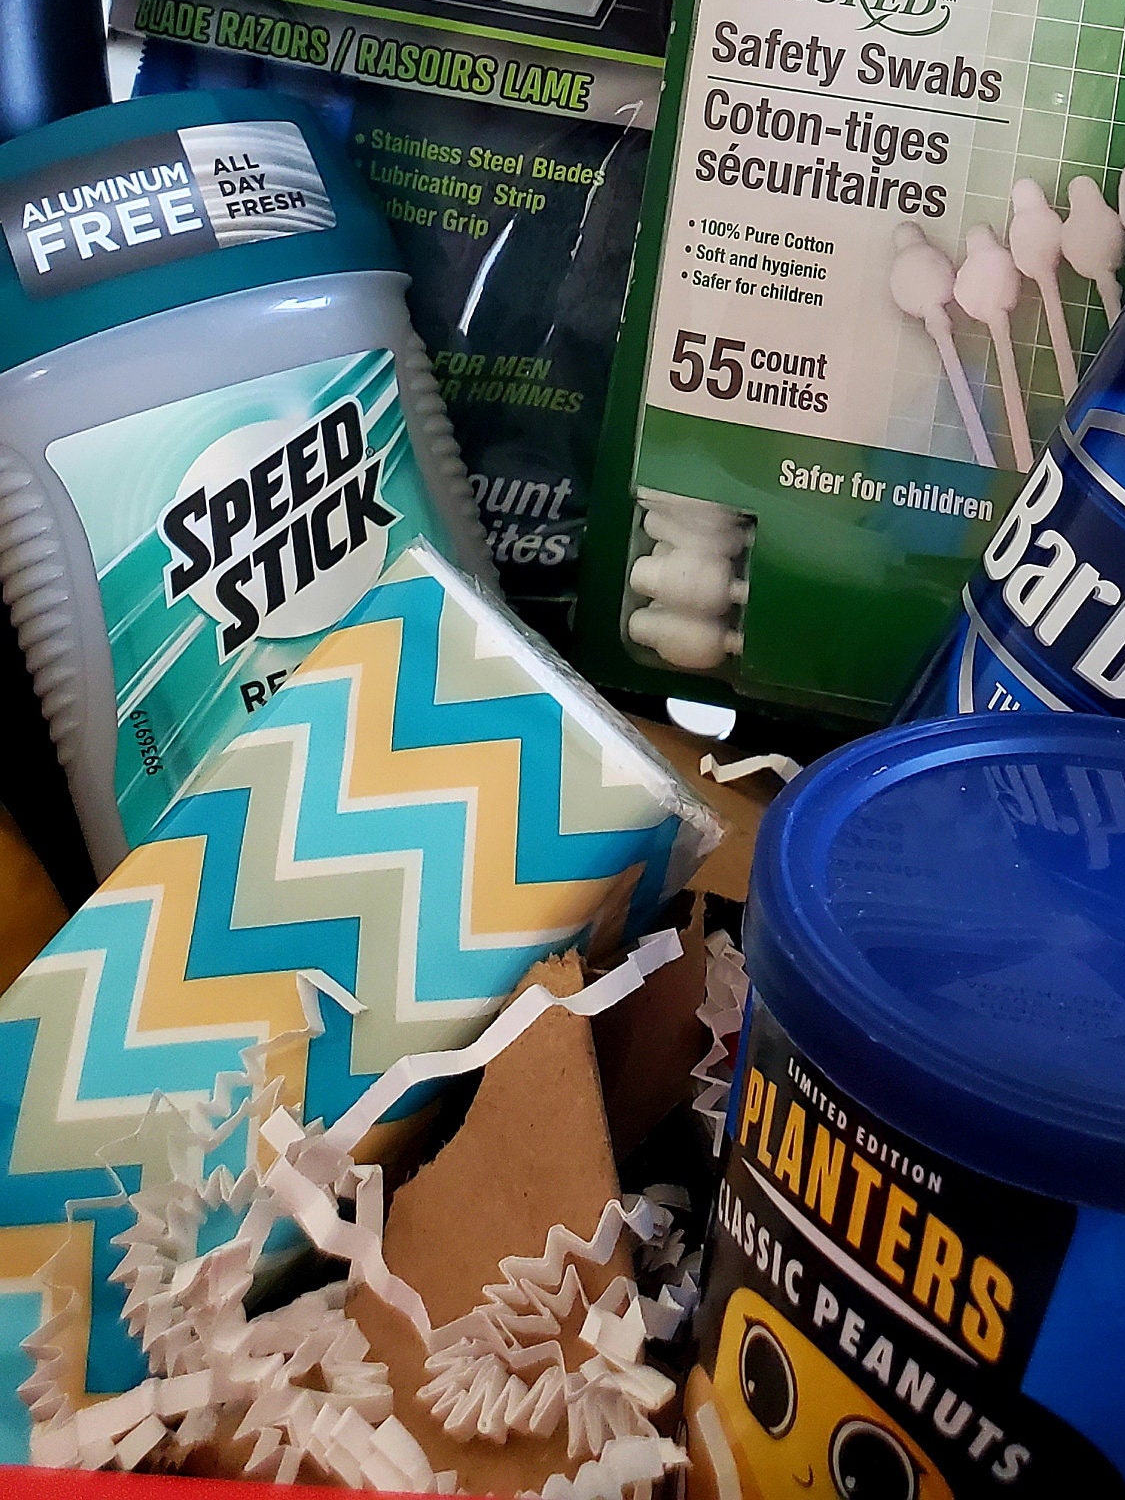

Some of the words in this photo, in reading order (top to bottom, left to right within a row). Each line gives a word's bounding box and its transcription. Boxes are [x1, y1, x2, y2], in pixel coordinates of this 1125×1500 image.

[216, 11, 329, 65] RAZORS
[355, 35, 497, 94] RASOIRS
[500, 62, 595, 113] LAME
[711, 21, 846, 87] Safety
[857, 42, 1003, 103] Swabs
[371, 129, 462, 165] Stainless
[467, 146, 524, 176] Steel
[532, 157, 606, 187] Blades
[703, 88, 951, 166] Coton-tiges
[21, 161, 189, 230] ALUMINUM
[212, 152, 260, 176] ALL
[219, 174, 267, 197] DAY
[370, 160, 482, 206] Lubricating
[493, 183, 547, 215] Strip
[695, 143, 948, 218] sécuritaires
[26, 189, 204, 275] FREE
[226, 190, 306, 220] FRESH
[442, 208, 489, 240] Grip
[700, 218, 741, 241] 100%
[744, 225, 781, 246] Pure
[784, 232, 835, 255] Cotton
[692, 270, 733, 294] Safer
[735, 277, 758, 297] for
[760, 281, 825, 307] children
[696, 244, 726, 265] Soft
[729, 249, 758, 269] and
[761, 254, 828, 281] hygienic
[492, 355, 552, 380] MEN
[669, 329, 747, 400] 55
[750, 348, 829, 381] count
[746, 377, 830, 413] unités
[163, 401, 364, 600] SPEED
[779, 459, 846, 496] Safer
[850, 472, 887, 503] for
[892, 481, 995, 522] children
[217, 458, 397, 657] STICK
[786, 1056, 848, 1130] LIMITED
[856, 1125, 942, 1195] EDITION
[739, 1066, 1014, 1364] PLANTERS
[717, 1177, 804, 1306] CLASSIC
[811, 1283, 1033, 1482] PEANUTS
